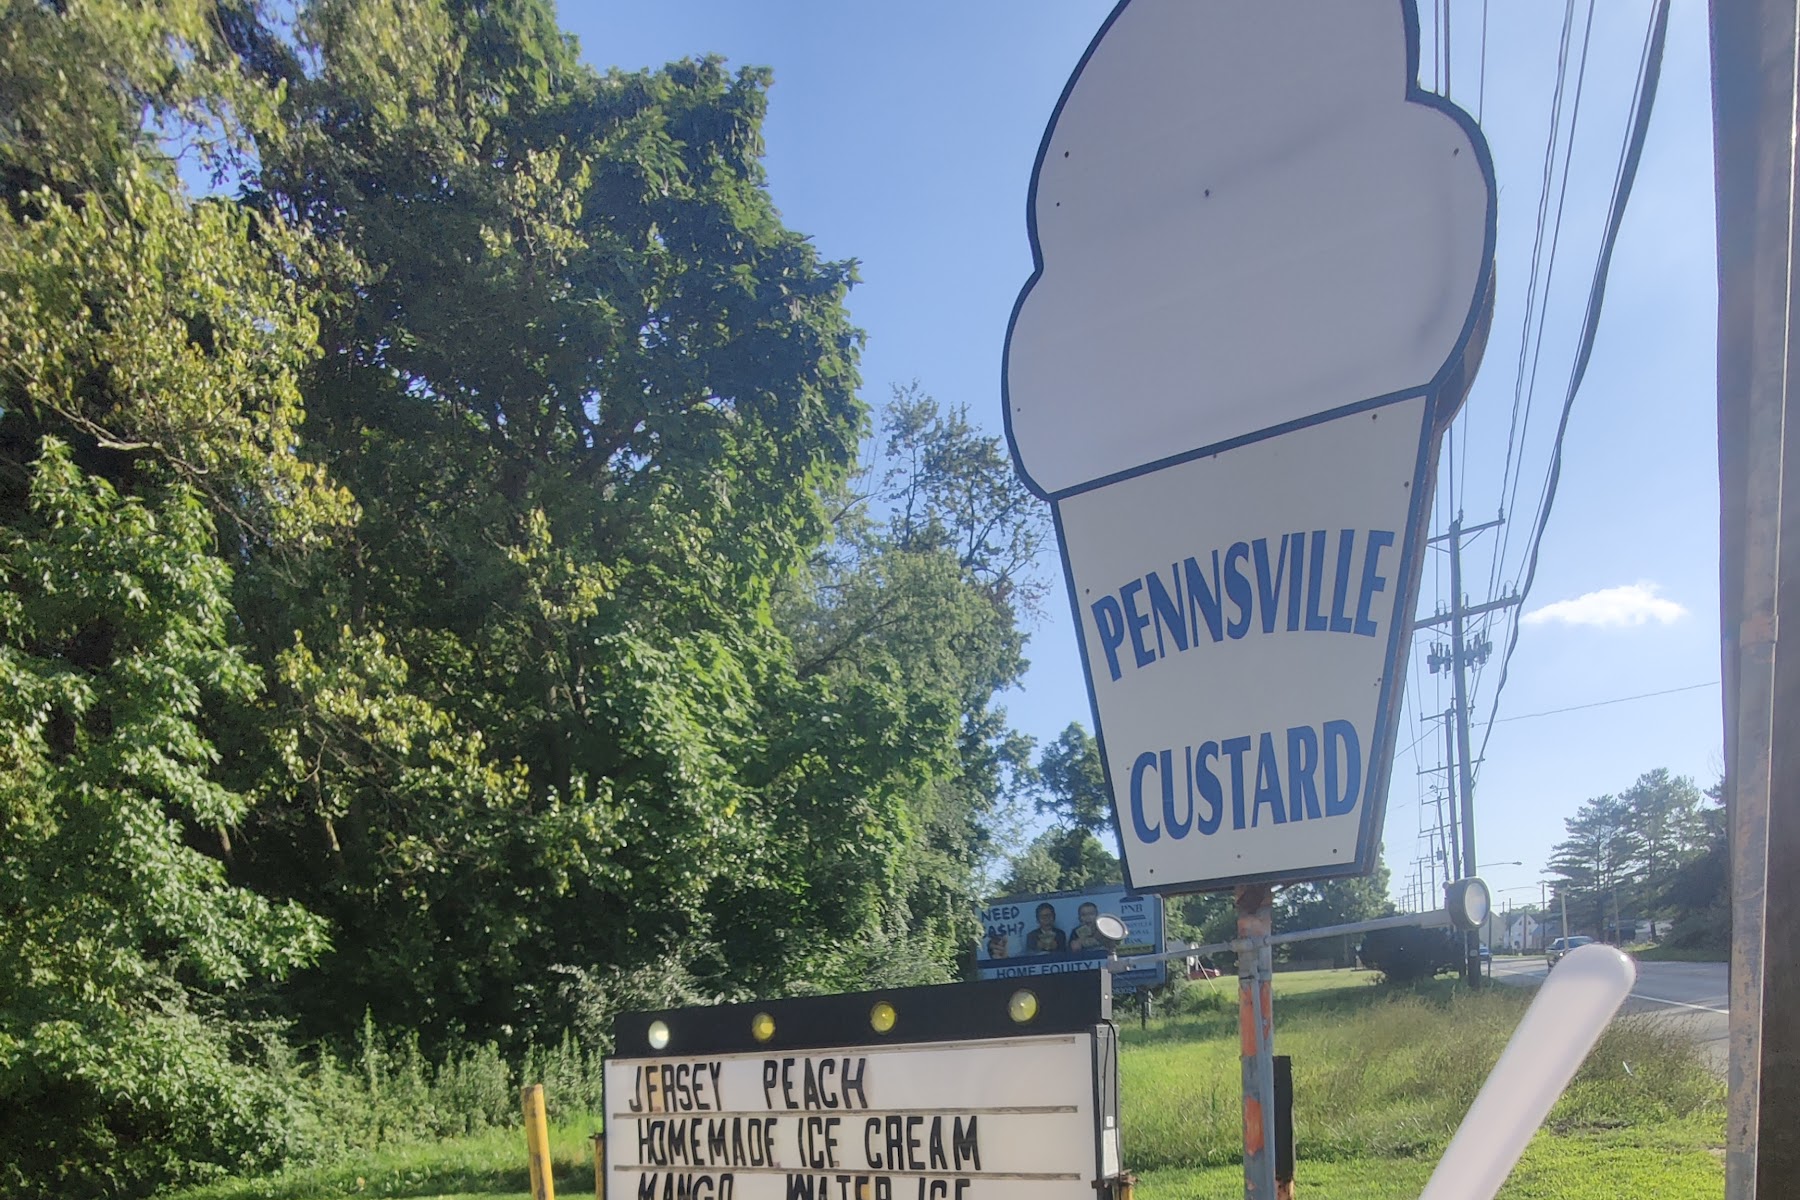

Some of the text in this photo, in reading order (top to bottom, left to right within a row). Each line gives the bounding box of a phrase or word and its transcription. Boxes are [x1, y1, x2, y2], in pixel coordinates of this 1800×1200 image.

[1090, 529, 1396, 682] PENNSVILLE
[1130, 719, 1361, 844] CUSTARD
[981, 905, 1020, 923] NEED
[1121, 904, 1143, 914] PNB
[996, 966, 1036, 979] HOME
[1041, 961, 1093, 975] EQUITY
[629, 1058, 868, 1112] JERSEY PEACH
[638, 1115, 981, 1171] HOMEMADE ICE CREAM
